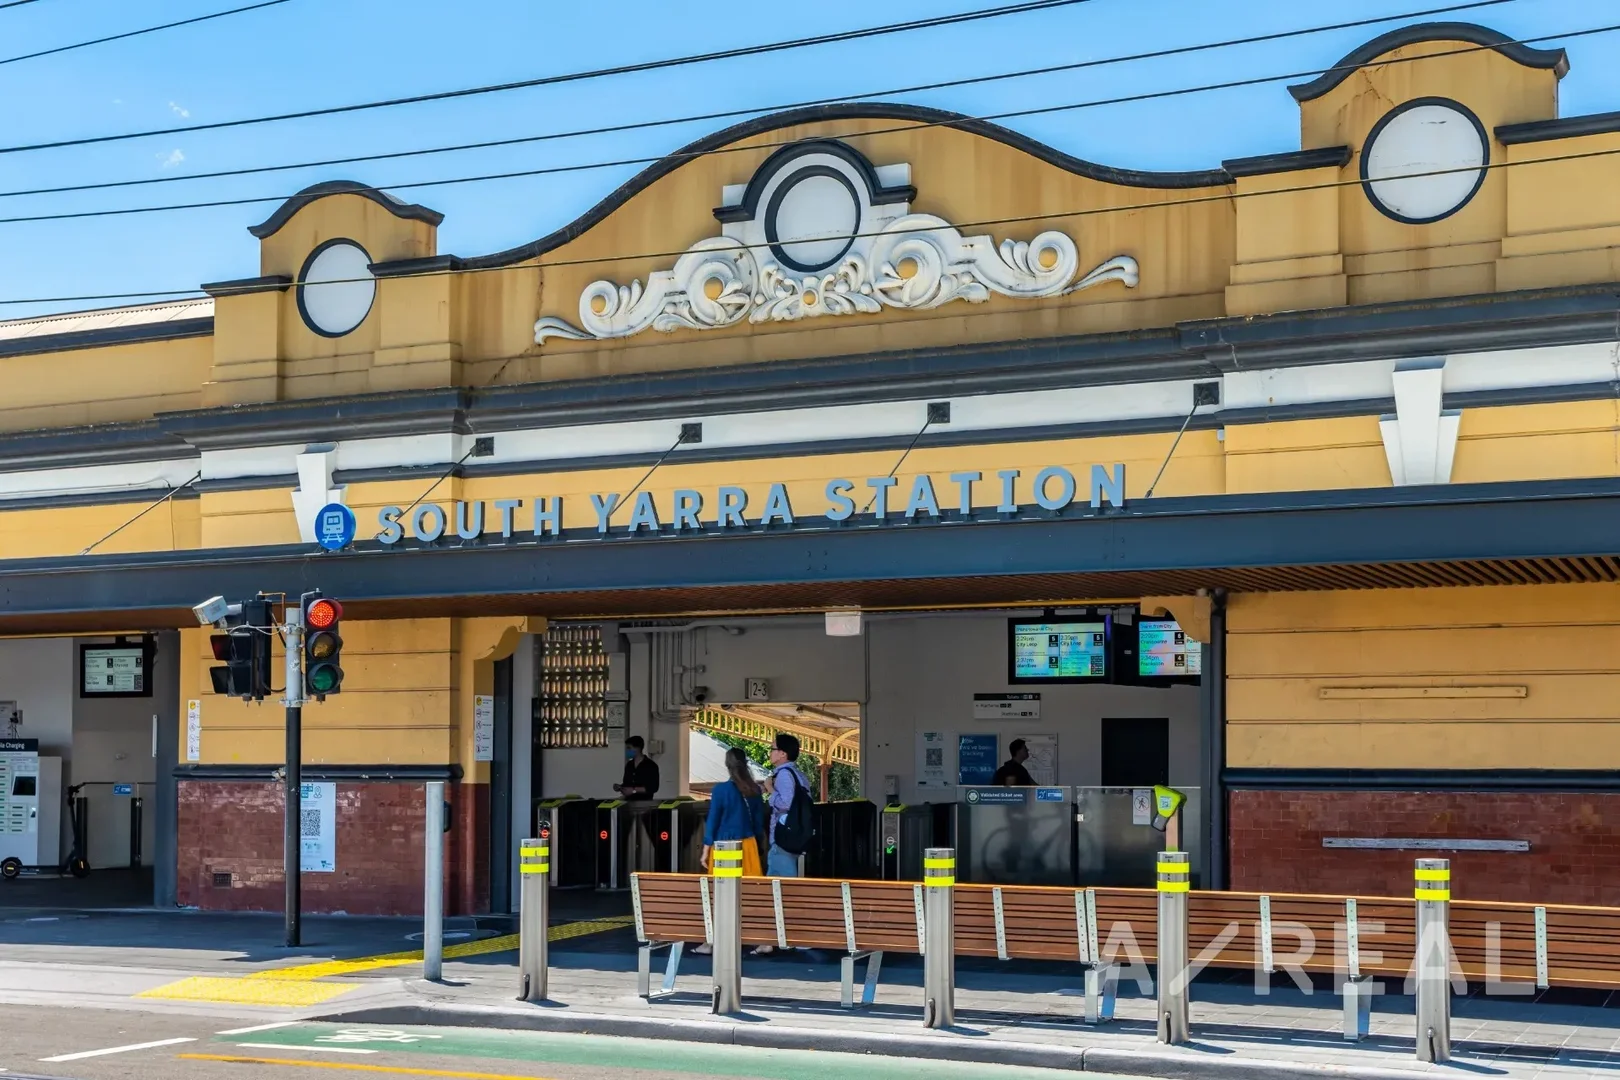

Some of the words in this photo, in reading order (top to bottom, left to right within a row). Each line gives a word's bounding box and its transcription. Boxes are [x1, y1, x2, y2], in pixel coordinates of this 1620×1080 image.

[377, 496, 564, 545] SOUTH
[590, 483, 796, 533] YARRA
[824, 463, 1126, 521] STATION
[753, 682, 767, 697] 2-3
[5, 742, 25, 750] Charging
